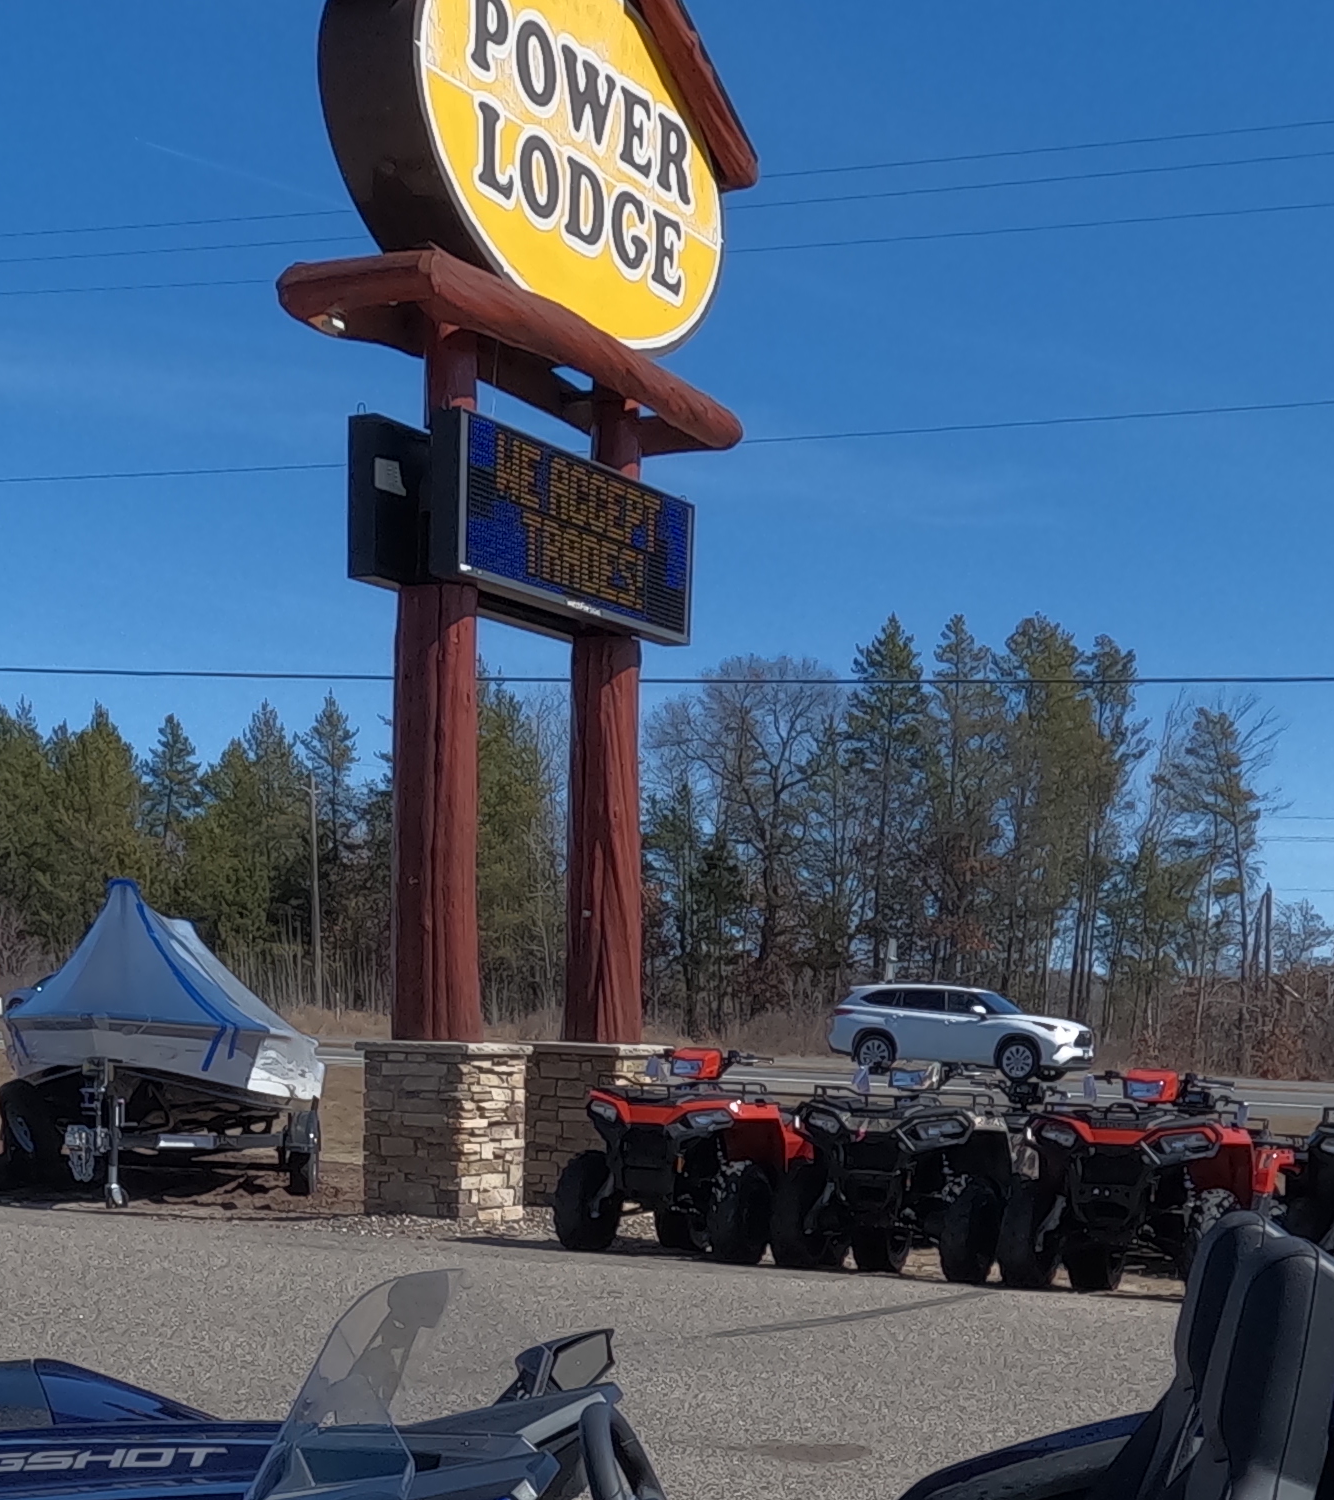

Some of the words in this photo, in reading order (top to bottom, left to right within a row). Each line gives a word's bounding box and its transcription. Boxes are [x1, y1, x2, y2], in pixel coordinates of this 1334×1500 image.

[471, 0, 690, 205] POWER
[478, 101, 682, 297] LODGE
[496, 432, 541, 509] WE
[549, 456, 661, 552] ACCEPT
